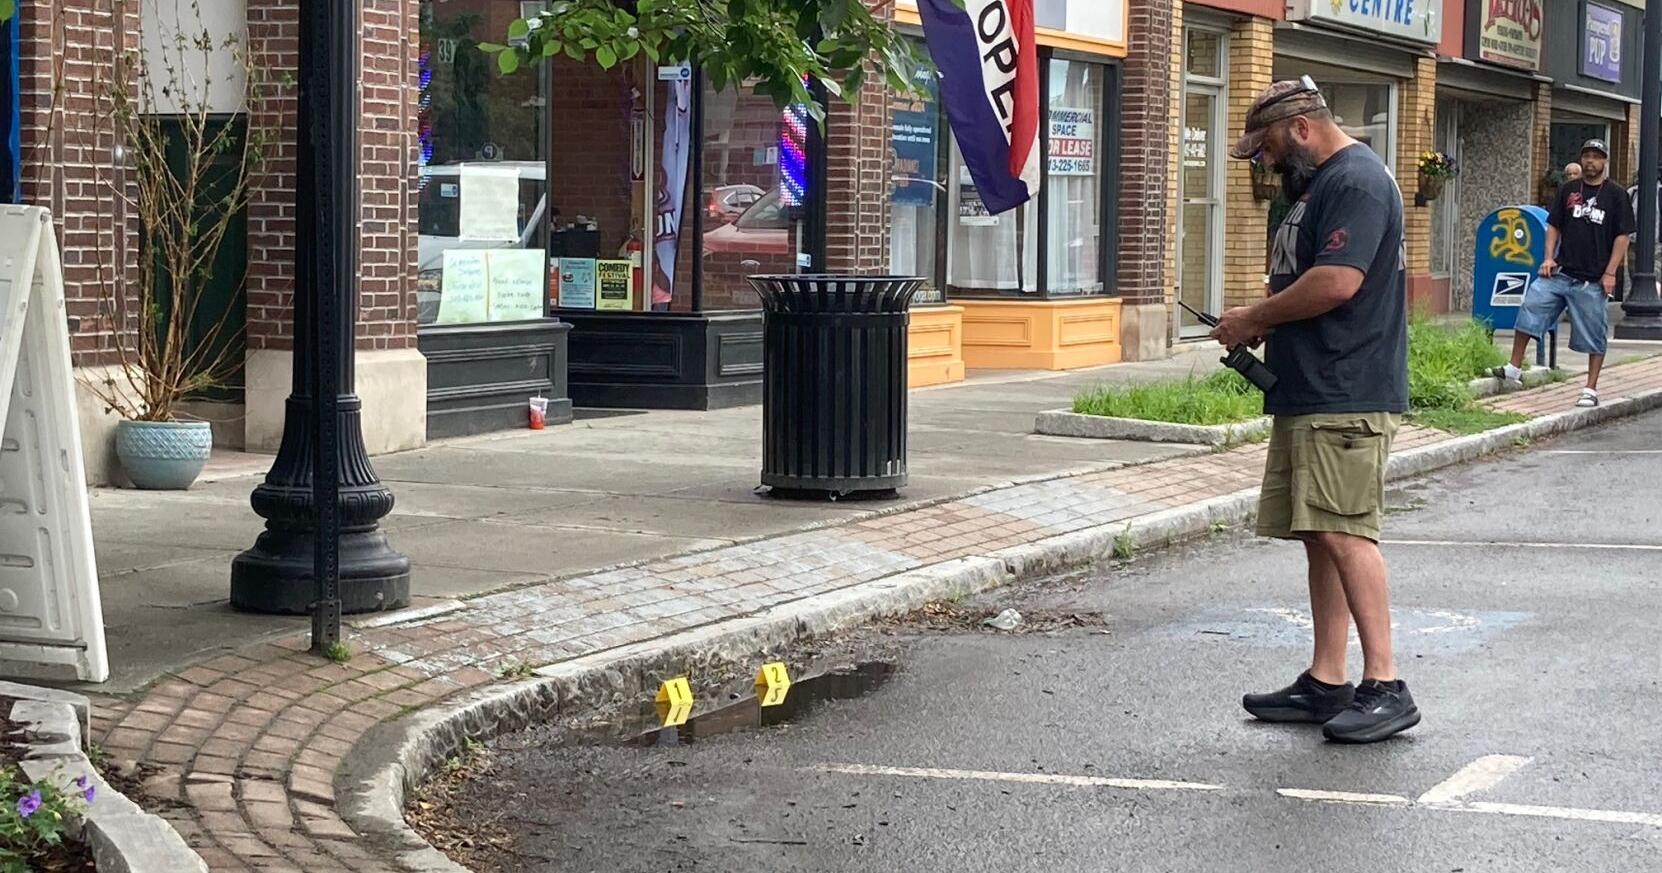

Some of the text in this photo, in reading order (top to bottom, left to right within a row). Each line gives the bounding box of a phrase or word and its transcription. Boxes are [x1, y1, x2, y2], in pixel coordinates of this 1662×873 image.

[978, 0, 1019, 134] OPE
[1048, 110, 1092, 124] OMMERCIAL
[1052, 124, 1077, 136] SPACE
[1061, 140, 1092, 156] LEASE
[599, 263, 630, 272] COMEDY
[599, 271, 631, 279] FESTIVAL
[771, 667, 781, 683] 2
[673, 682, 682, 700] 1
